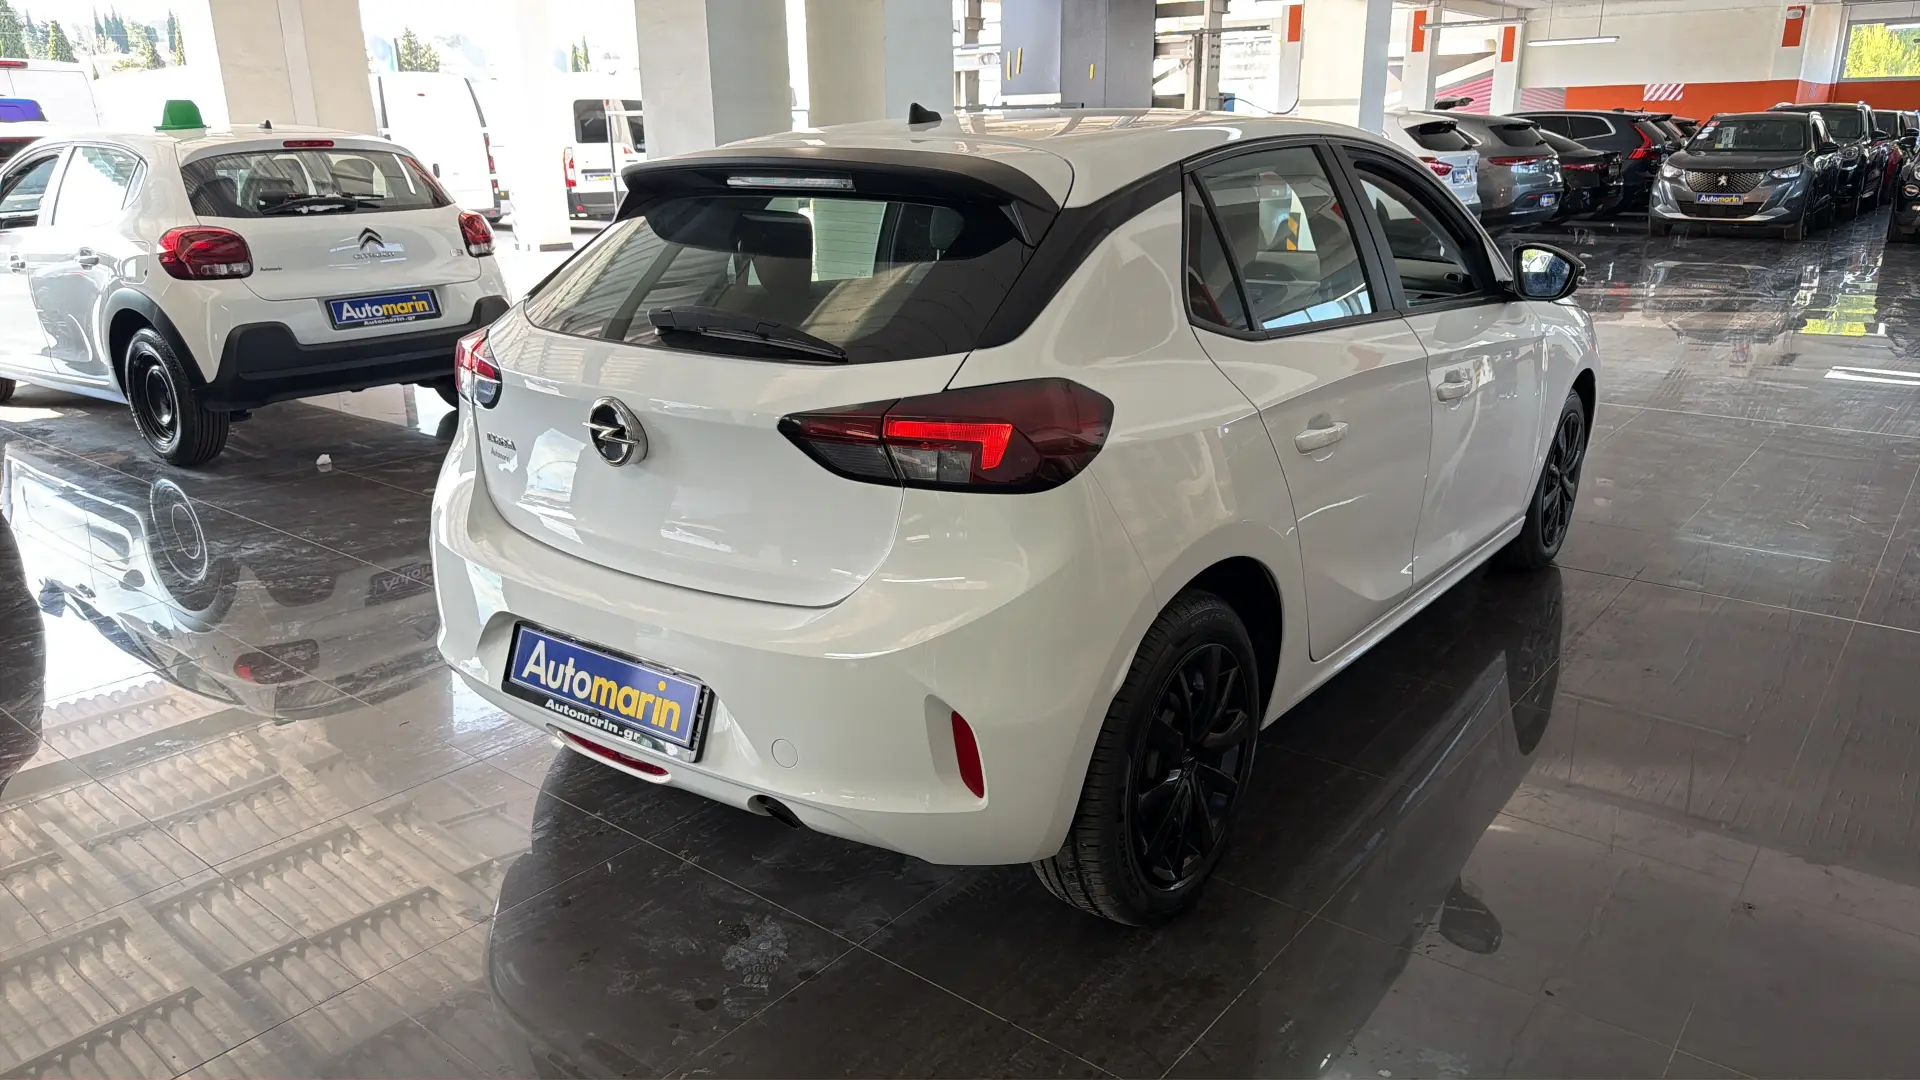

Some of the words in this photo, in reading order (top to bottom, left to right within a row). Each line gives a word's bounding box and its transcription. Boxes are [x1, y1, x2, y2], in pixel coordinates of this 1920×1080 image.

[342, 295, 430, 320] Automarin
[364, 315, 416, 326] Automarin.gr
[521, 639, 681, 732] Automarin
[544, 698, 641, 741] Automarin.gr
